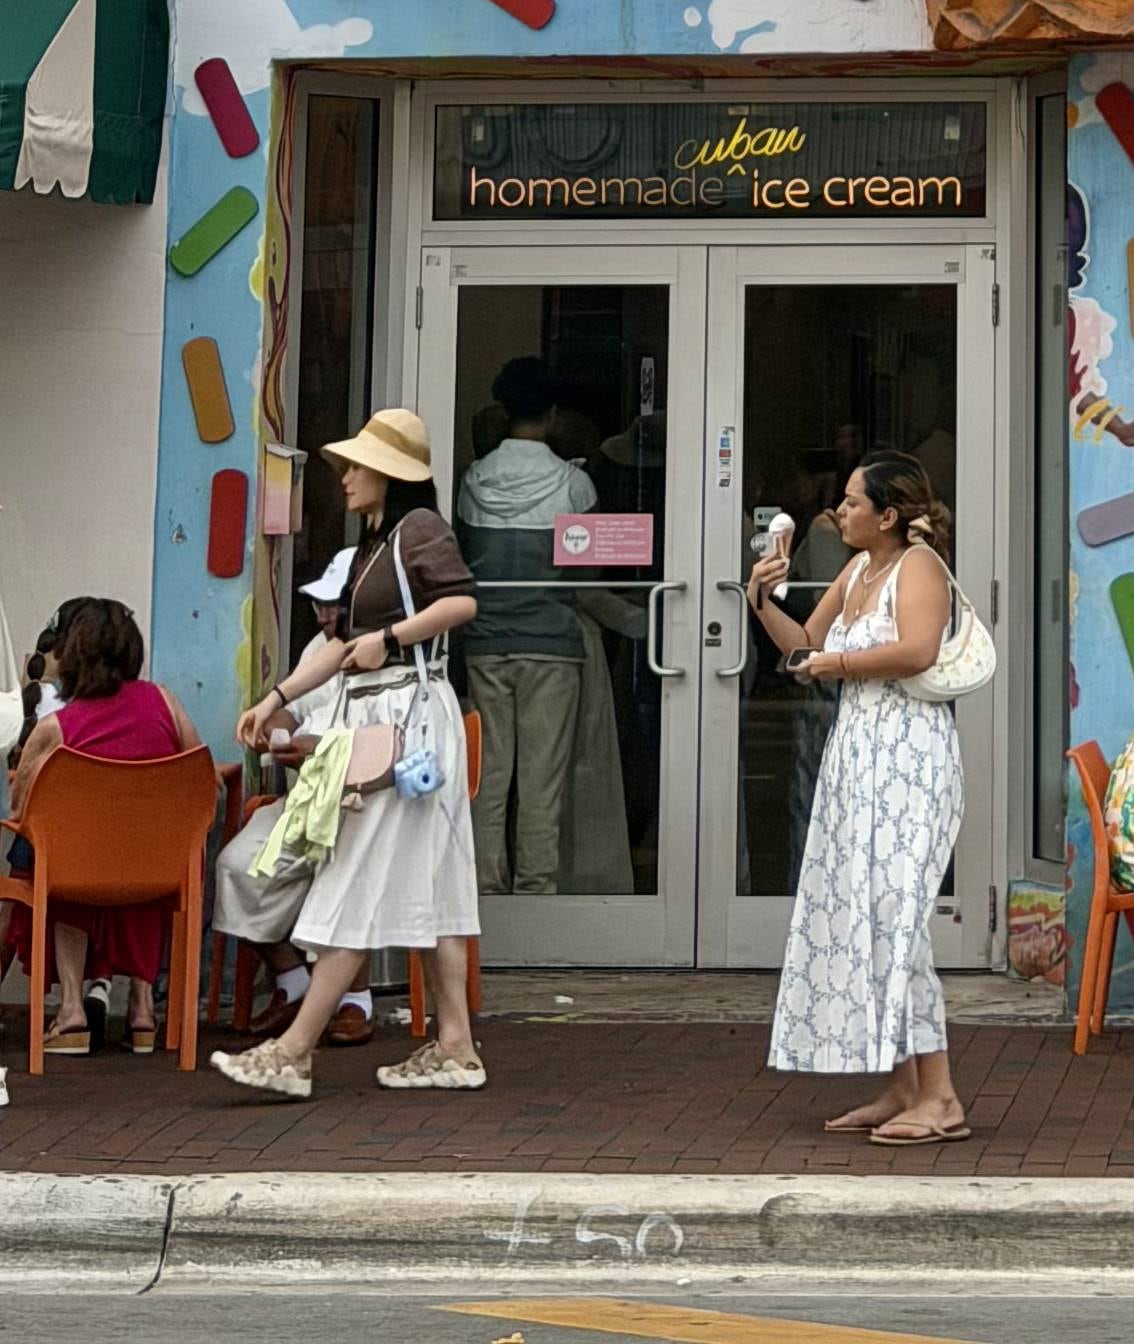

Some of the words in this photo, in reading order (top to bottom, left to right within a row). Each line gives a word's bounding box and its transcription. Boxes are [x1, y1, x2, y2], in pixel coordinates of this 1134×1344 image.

[674, 117, 807, 170] cuban
[470, 166, 725, 207] homemade
[752, 168, 811, 208] ice
[823, 175, 962, 207] cream
